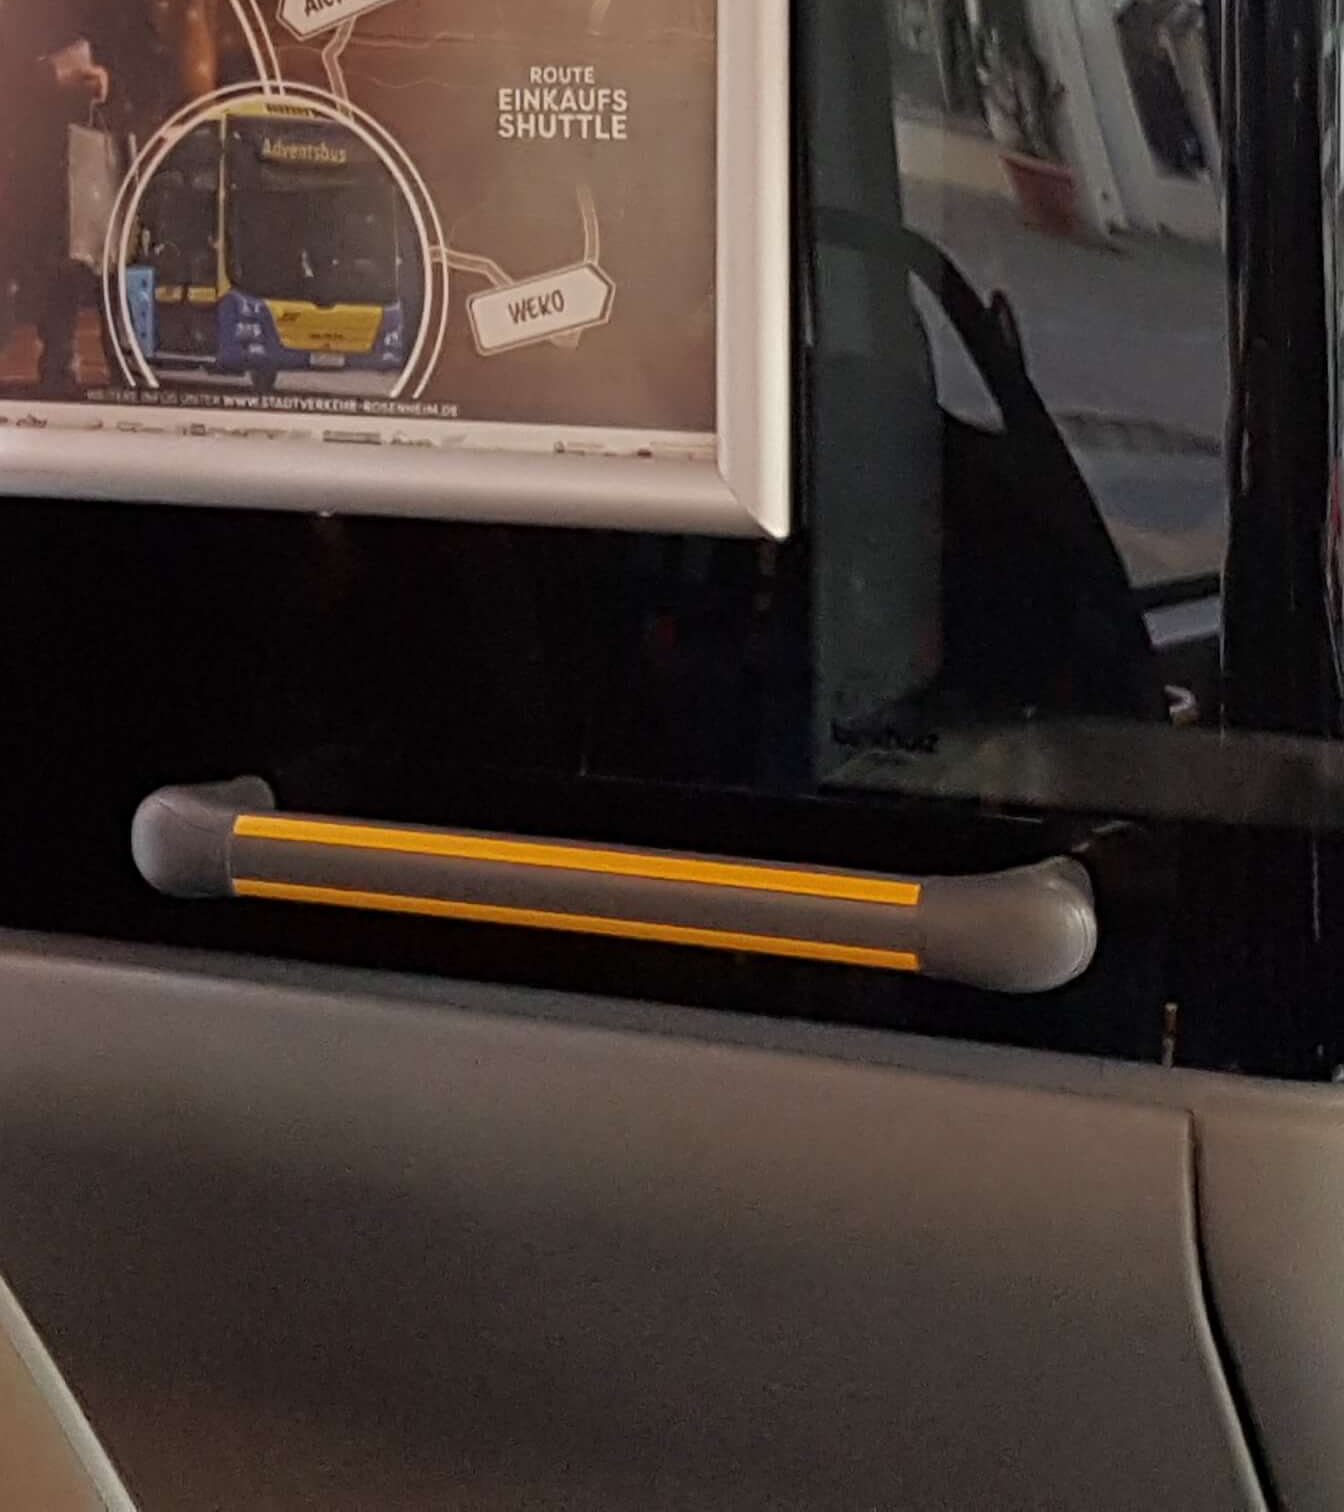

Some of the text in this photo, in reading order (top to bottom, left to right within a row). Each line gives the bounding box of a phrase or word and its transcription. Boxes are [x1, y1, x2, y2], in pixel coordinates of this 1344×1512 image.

[530, 66, 595, 85] ROUTE
[498, 88, 628, 112] EINKAUFS
[498, 114, 628, 140] SHUTTLE
[262, 137, 348, 164] Adventsbus
[508, 289, 566, 324] WEKO
